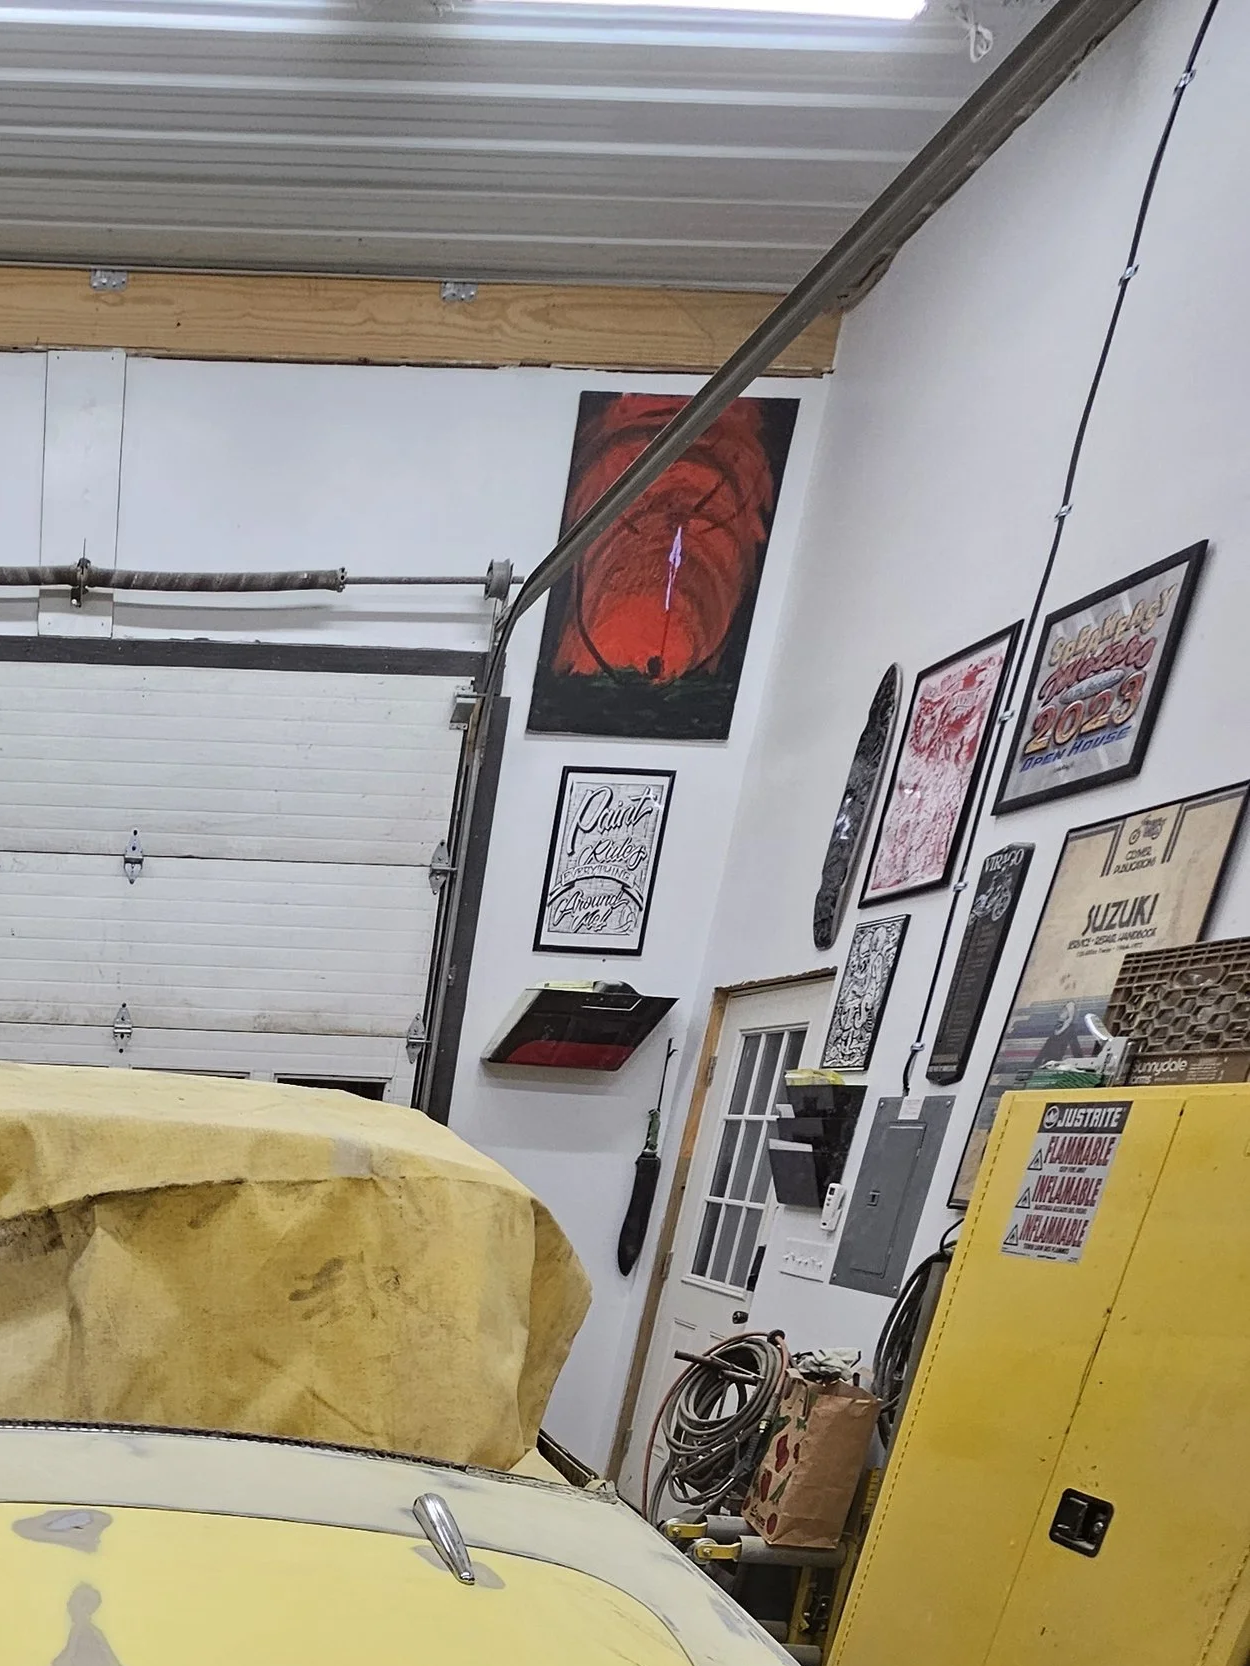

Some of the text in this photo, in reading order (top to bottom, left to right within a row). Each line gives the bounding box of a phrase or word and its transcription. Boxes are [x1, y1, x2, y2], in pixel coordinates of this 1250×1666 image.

[1048, 583, 1178, 666] SPEAKEASY
[1038, 635, 1157, 706] Motors
[1023, 670, 1147, 754] 2023
[567, 786, 654, 856] Paint
[578, 837, 647, 870] Rules
[985, 849, 1024, 872] VIRAGO
[563, 865, 630, 883] EVERYTHING
[552, 889, 629, 926] Around
[1082, 893, 1159, 936] SUZUKI
[1056, 1107, 1123, 1127] JUSTRITE
[1043, 1136, 1117, 1166] FLAMMABLE
[1031, 1174, 1103, 1207] INFLAMABLE
[1018, 1213, 1089, 1248] INFLAMMABLE
